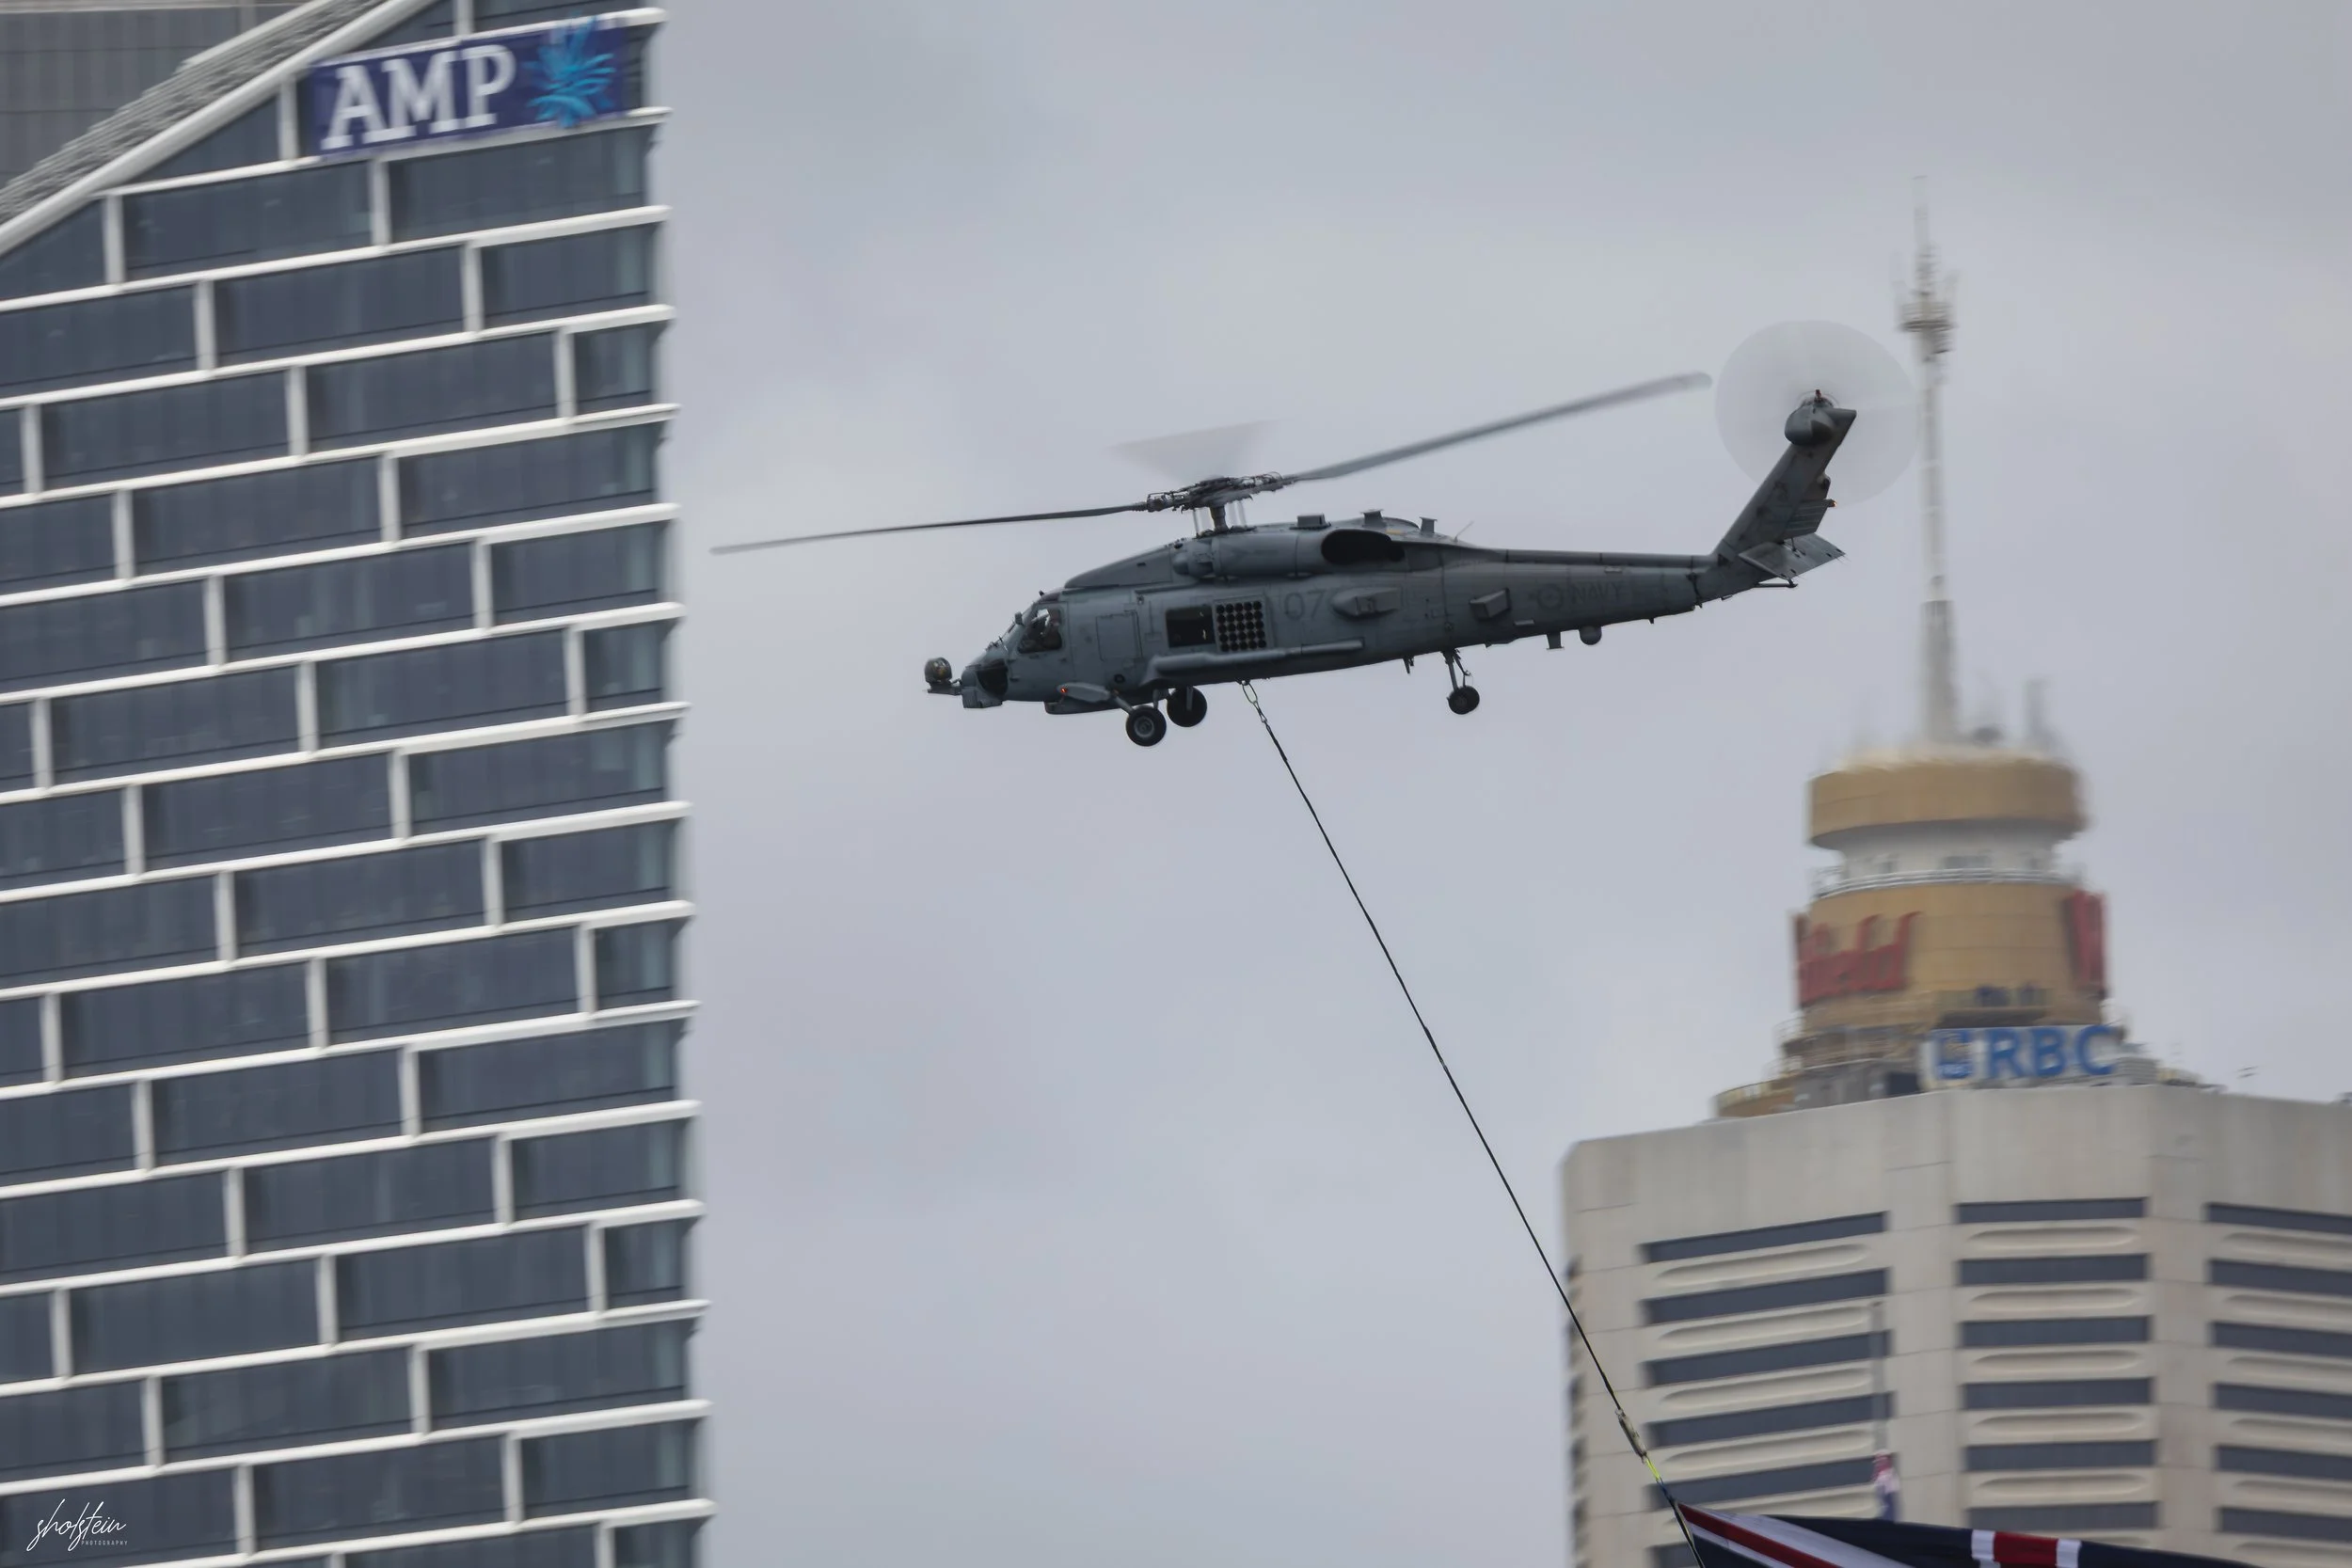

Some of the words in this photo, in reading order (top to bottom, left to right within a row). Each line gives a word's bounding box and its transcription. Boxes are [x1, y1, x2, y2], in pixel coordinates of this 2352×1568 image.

[321, 44, 516, 150] AMP
[1284, 589, 1327, 621] 07
[1570, 579, 1625, 605] NAVY
[1987, 1024, 2119, 1079] RBC
